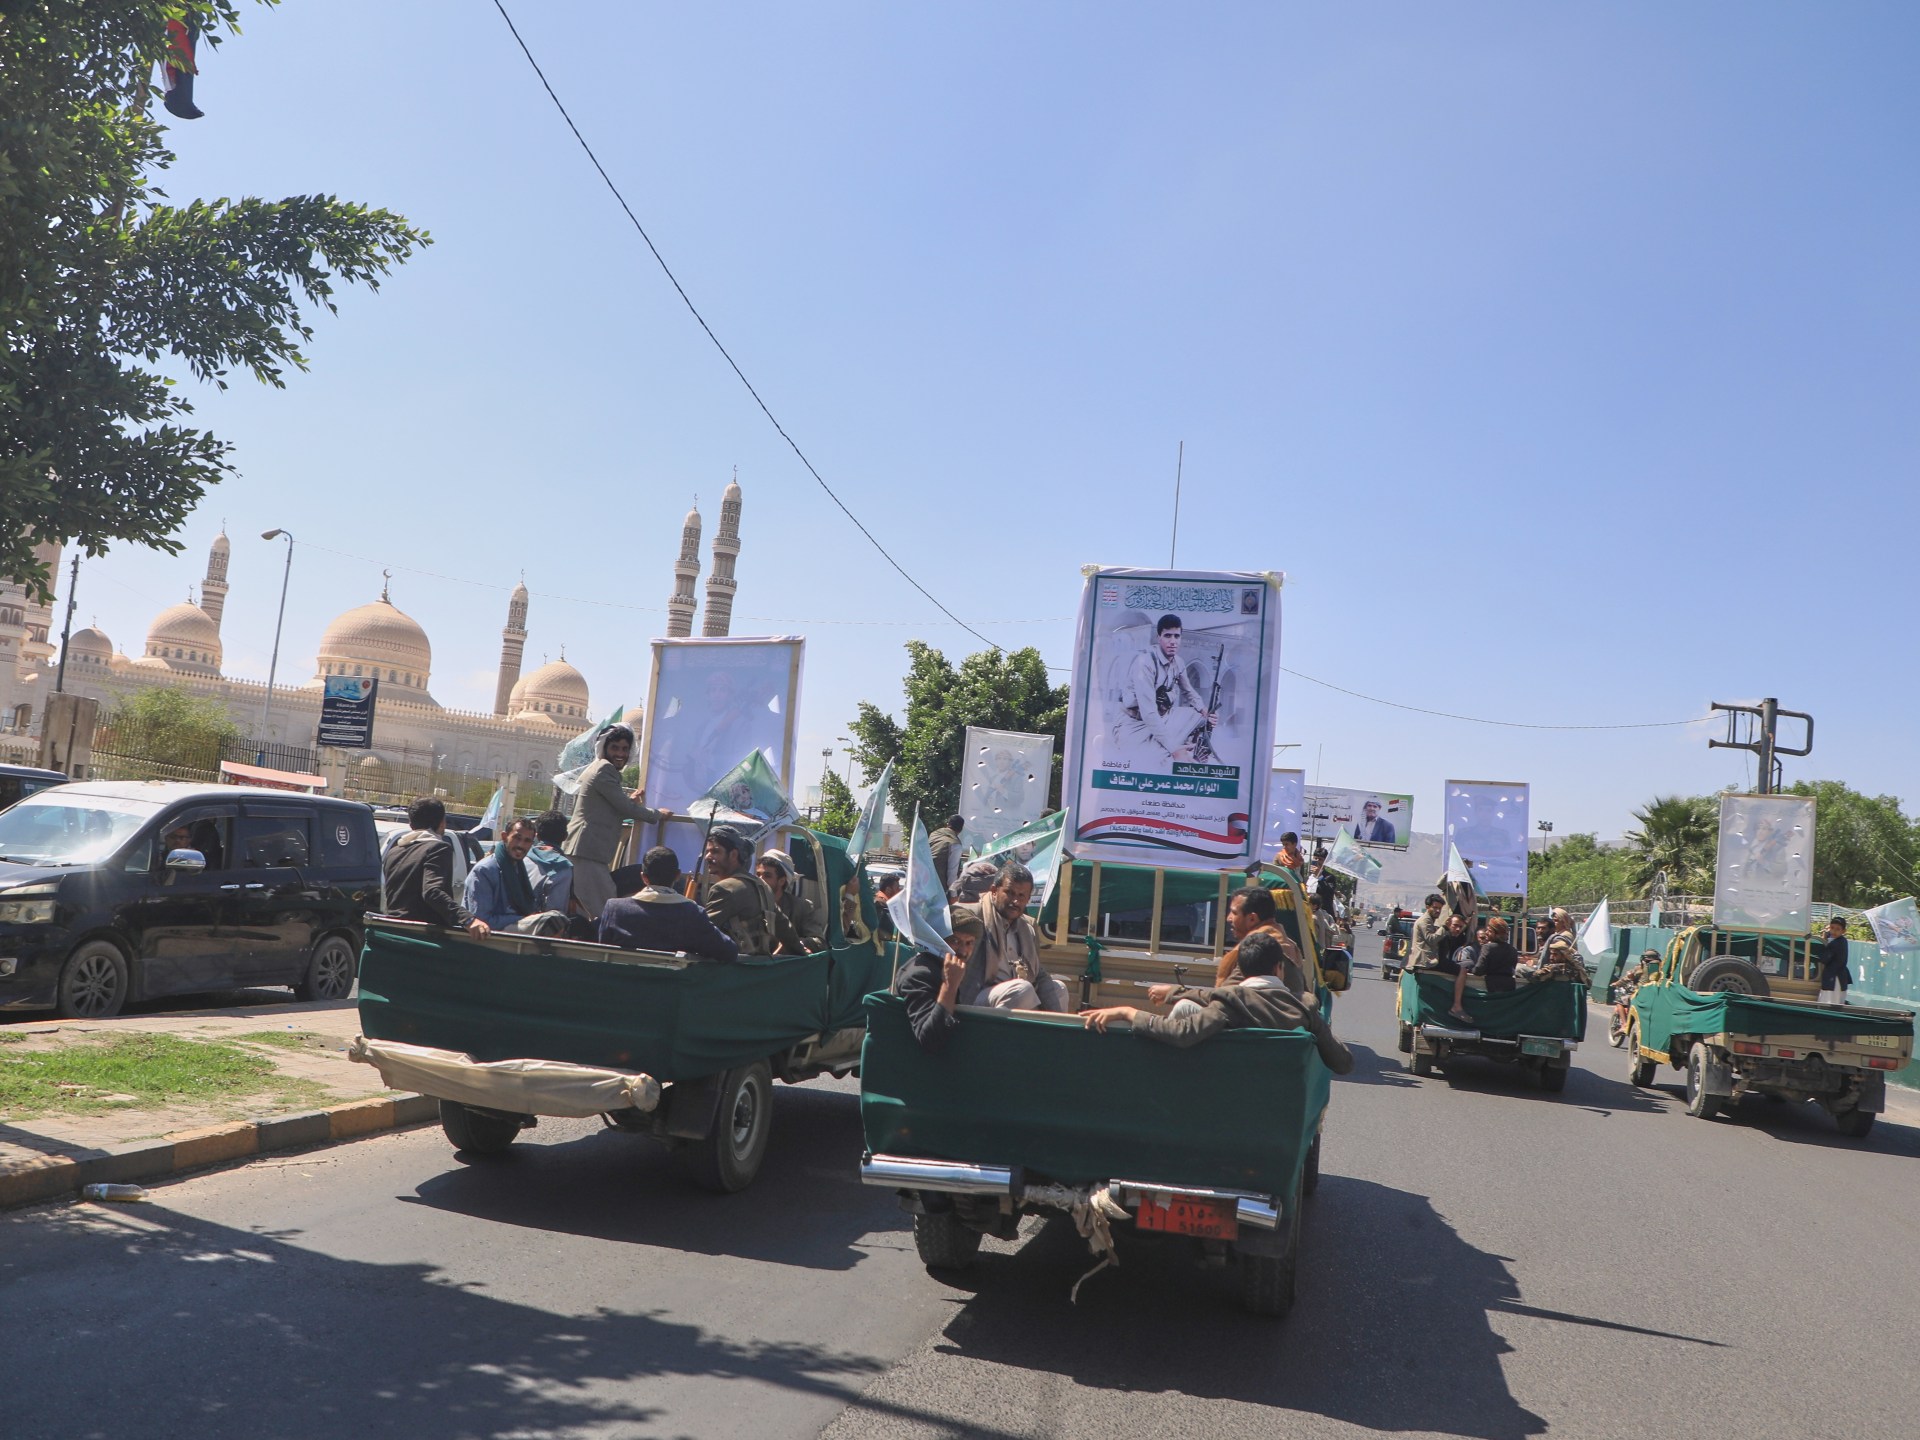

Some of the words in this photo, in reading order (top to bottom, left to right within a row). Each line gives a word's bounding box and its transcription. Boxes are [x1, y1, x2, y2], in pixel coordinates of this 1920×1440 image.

[1101, 759, 1122, 769] فاطمة
[1177, 764, 1209, 775] المجاهد
[1211, 766, 1236, 777] الشهيد
[1109, 773, 1138, 786] السقاف
[1138, 777, 1154, 792] علي
[1156, 780, 1172, 791] عمر
[1173, 780, 1195, 791] محمد
[1141, 799, 1161, 808] صنعاء
[1161, 801, 1186, 809] محافظة
[1214, 815, 1226, 823] تاريخ
